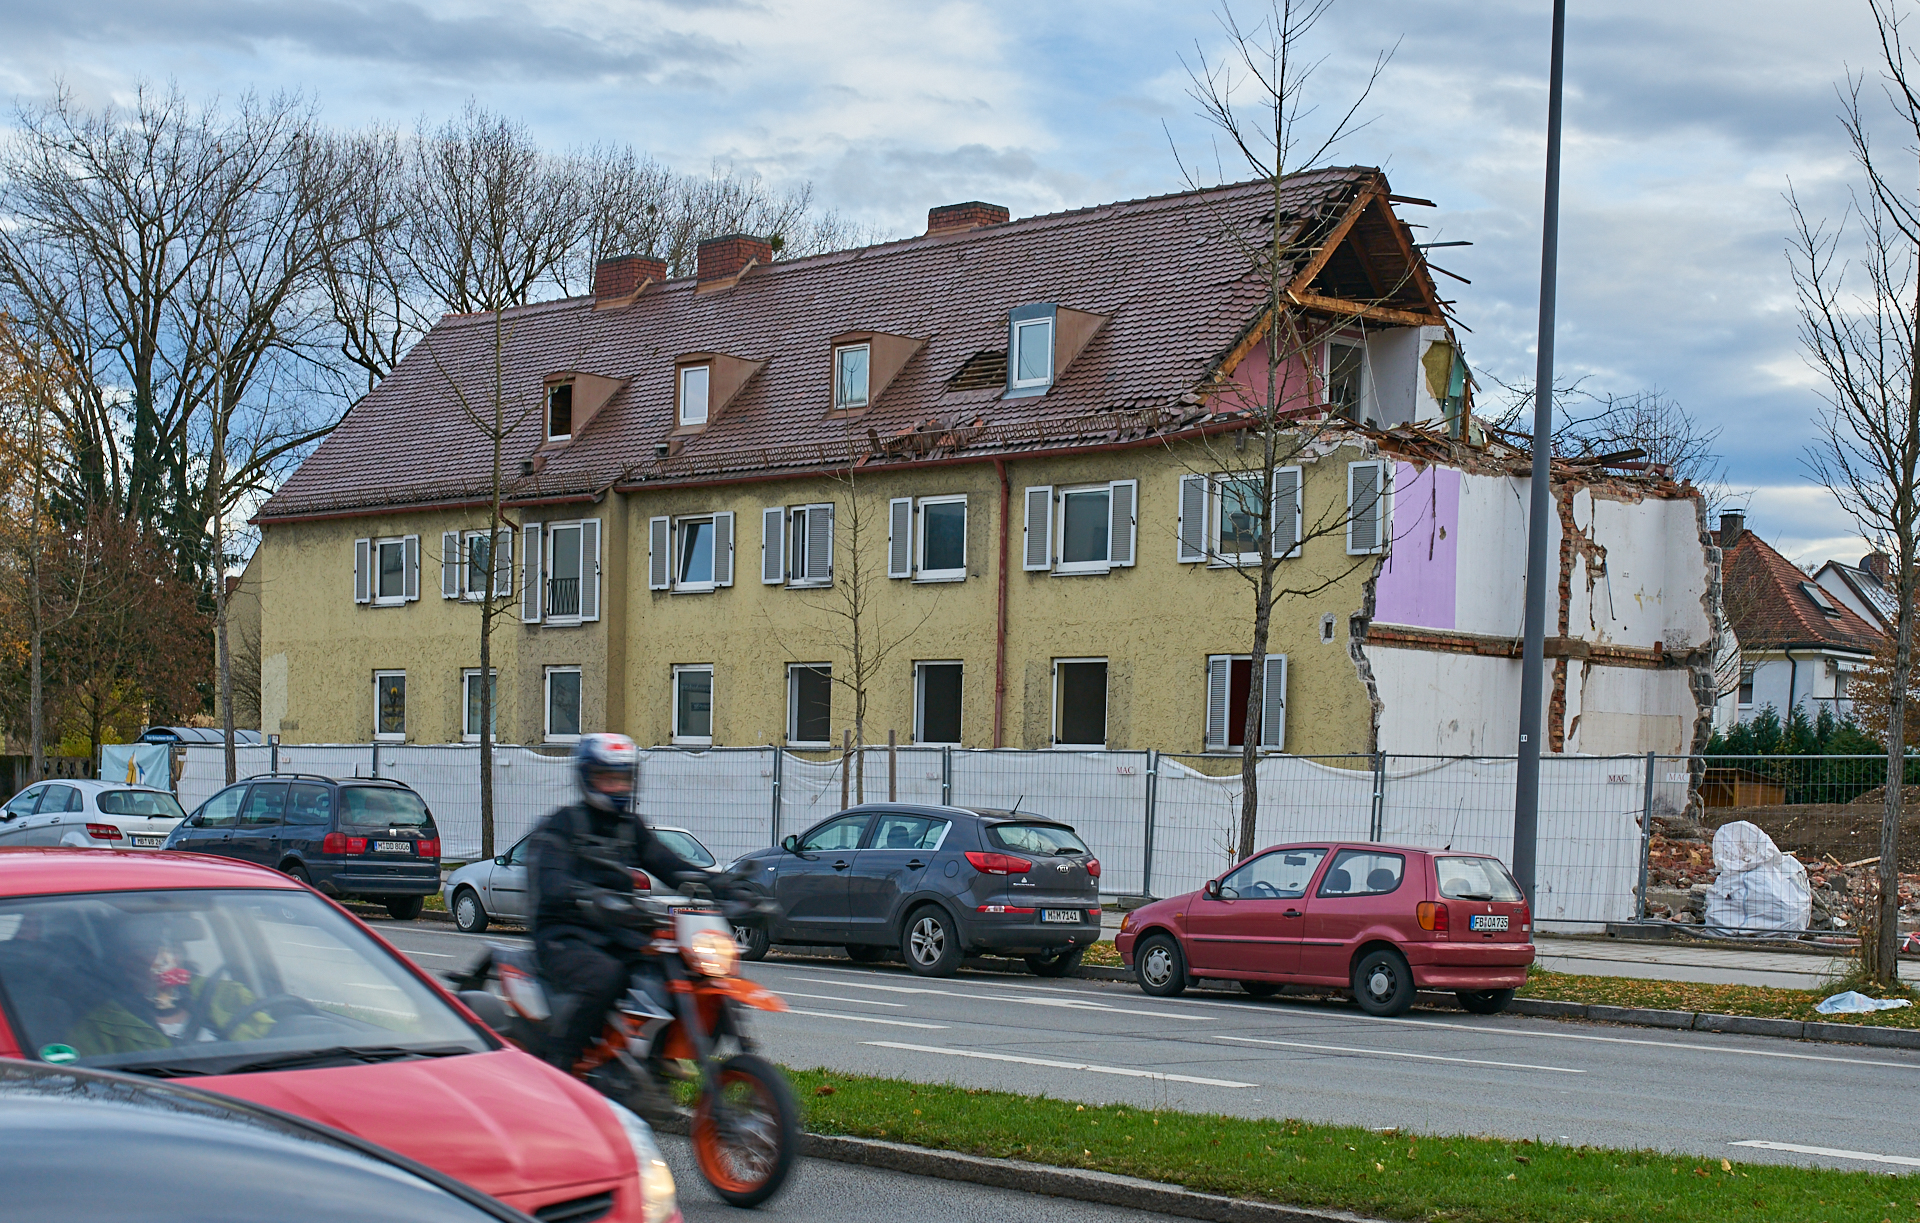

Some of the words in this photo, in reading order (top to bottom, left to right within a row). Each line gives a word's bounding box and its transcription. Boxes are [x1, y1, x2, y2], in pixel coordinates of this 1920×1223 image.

[1116, 766, 1134, 774] MAC
[1608, 774, 1628, 783] MAC
[1668, 773, 1688, 782] MAC
